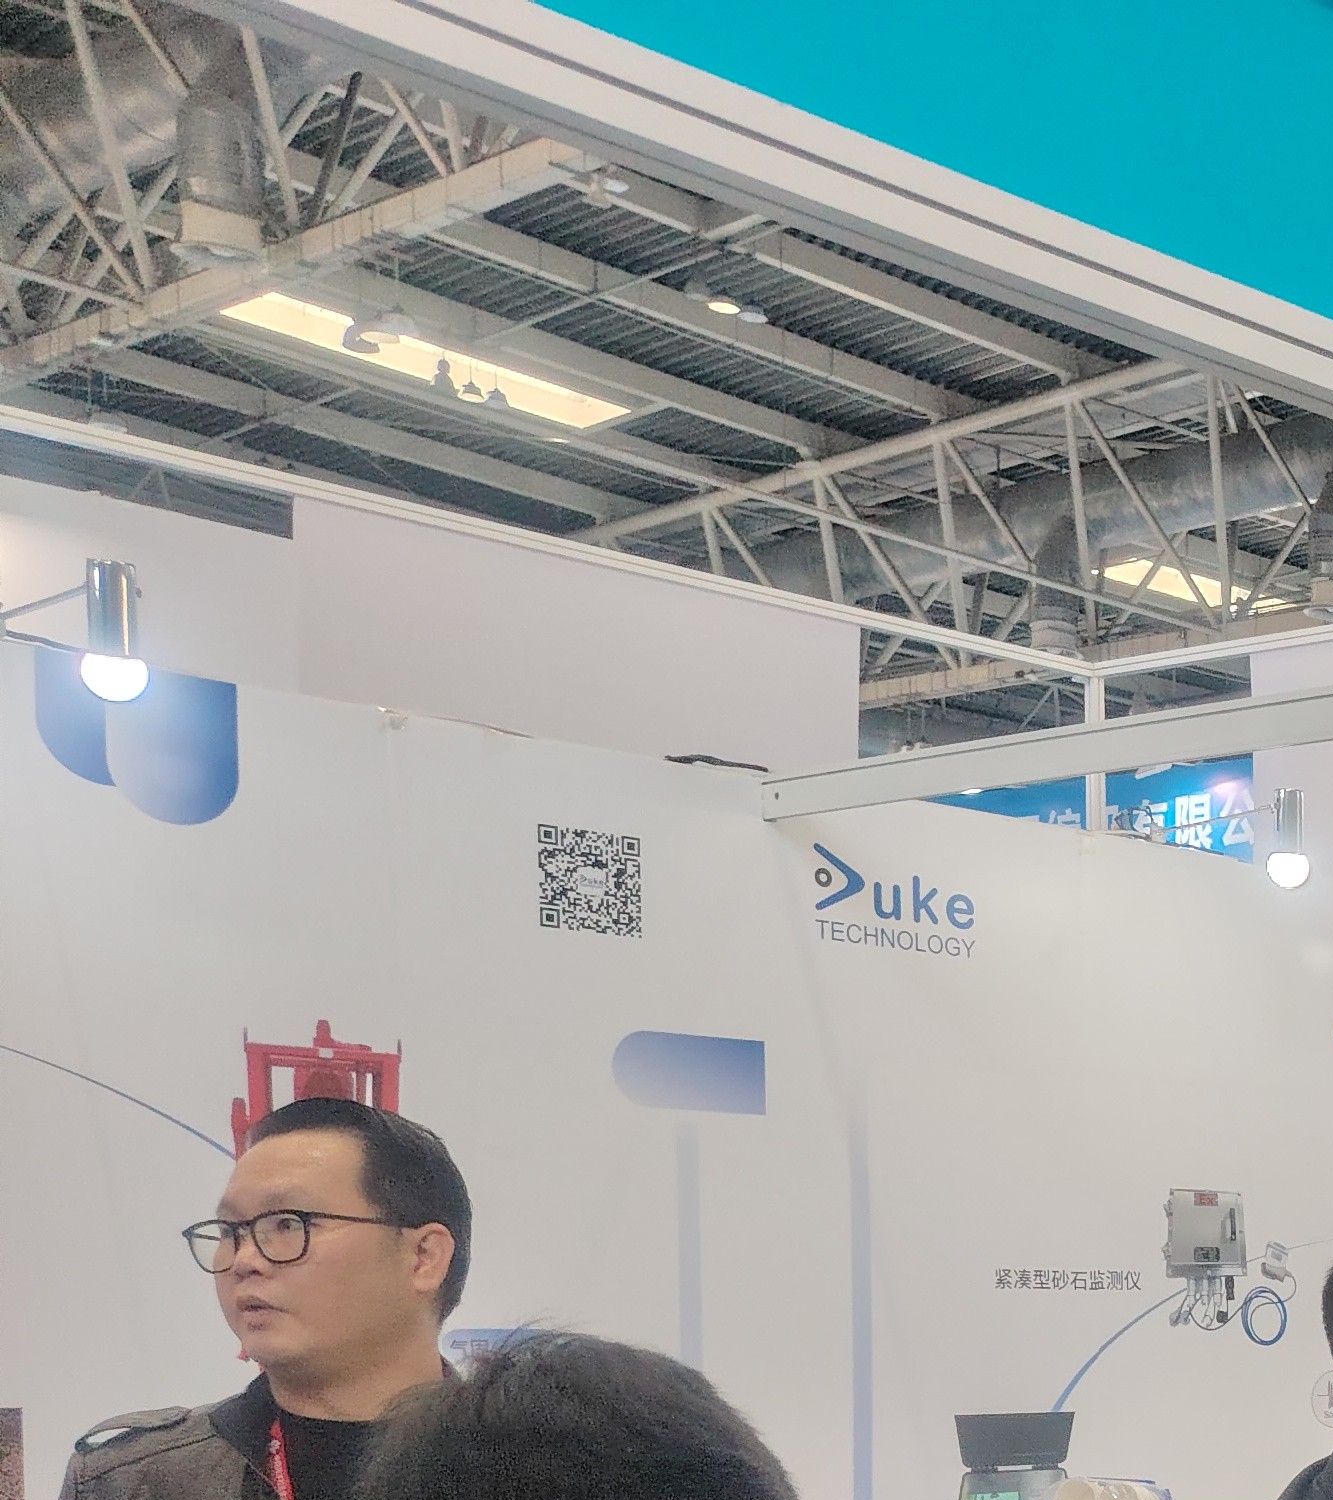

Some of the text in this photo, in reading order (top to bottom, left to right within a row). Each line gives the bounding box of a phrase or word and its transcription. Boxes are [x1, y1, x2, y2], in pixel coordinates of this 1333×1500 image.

[815, 919, 976, 958] TECHNOLOGY
[994, 1268, 1142, 1291] 紧凑型砂石监测仪
